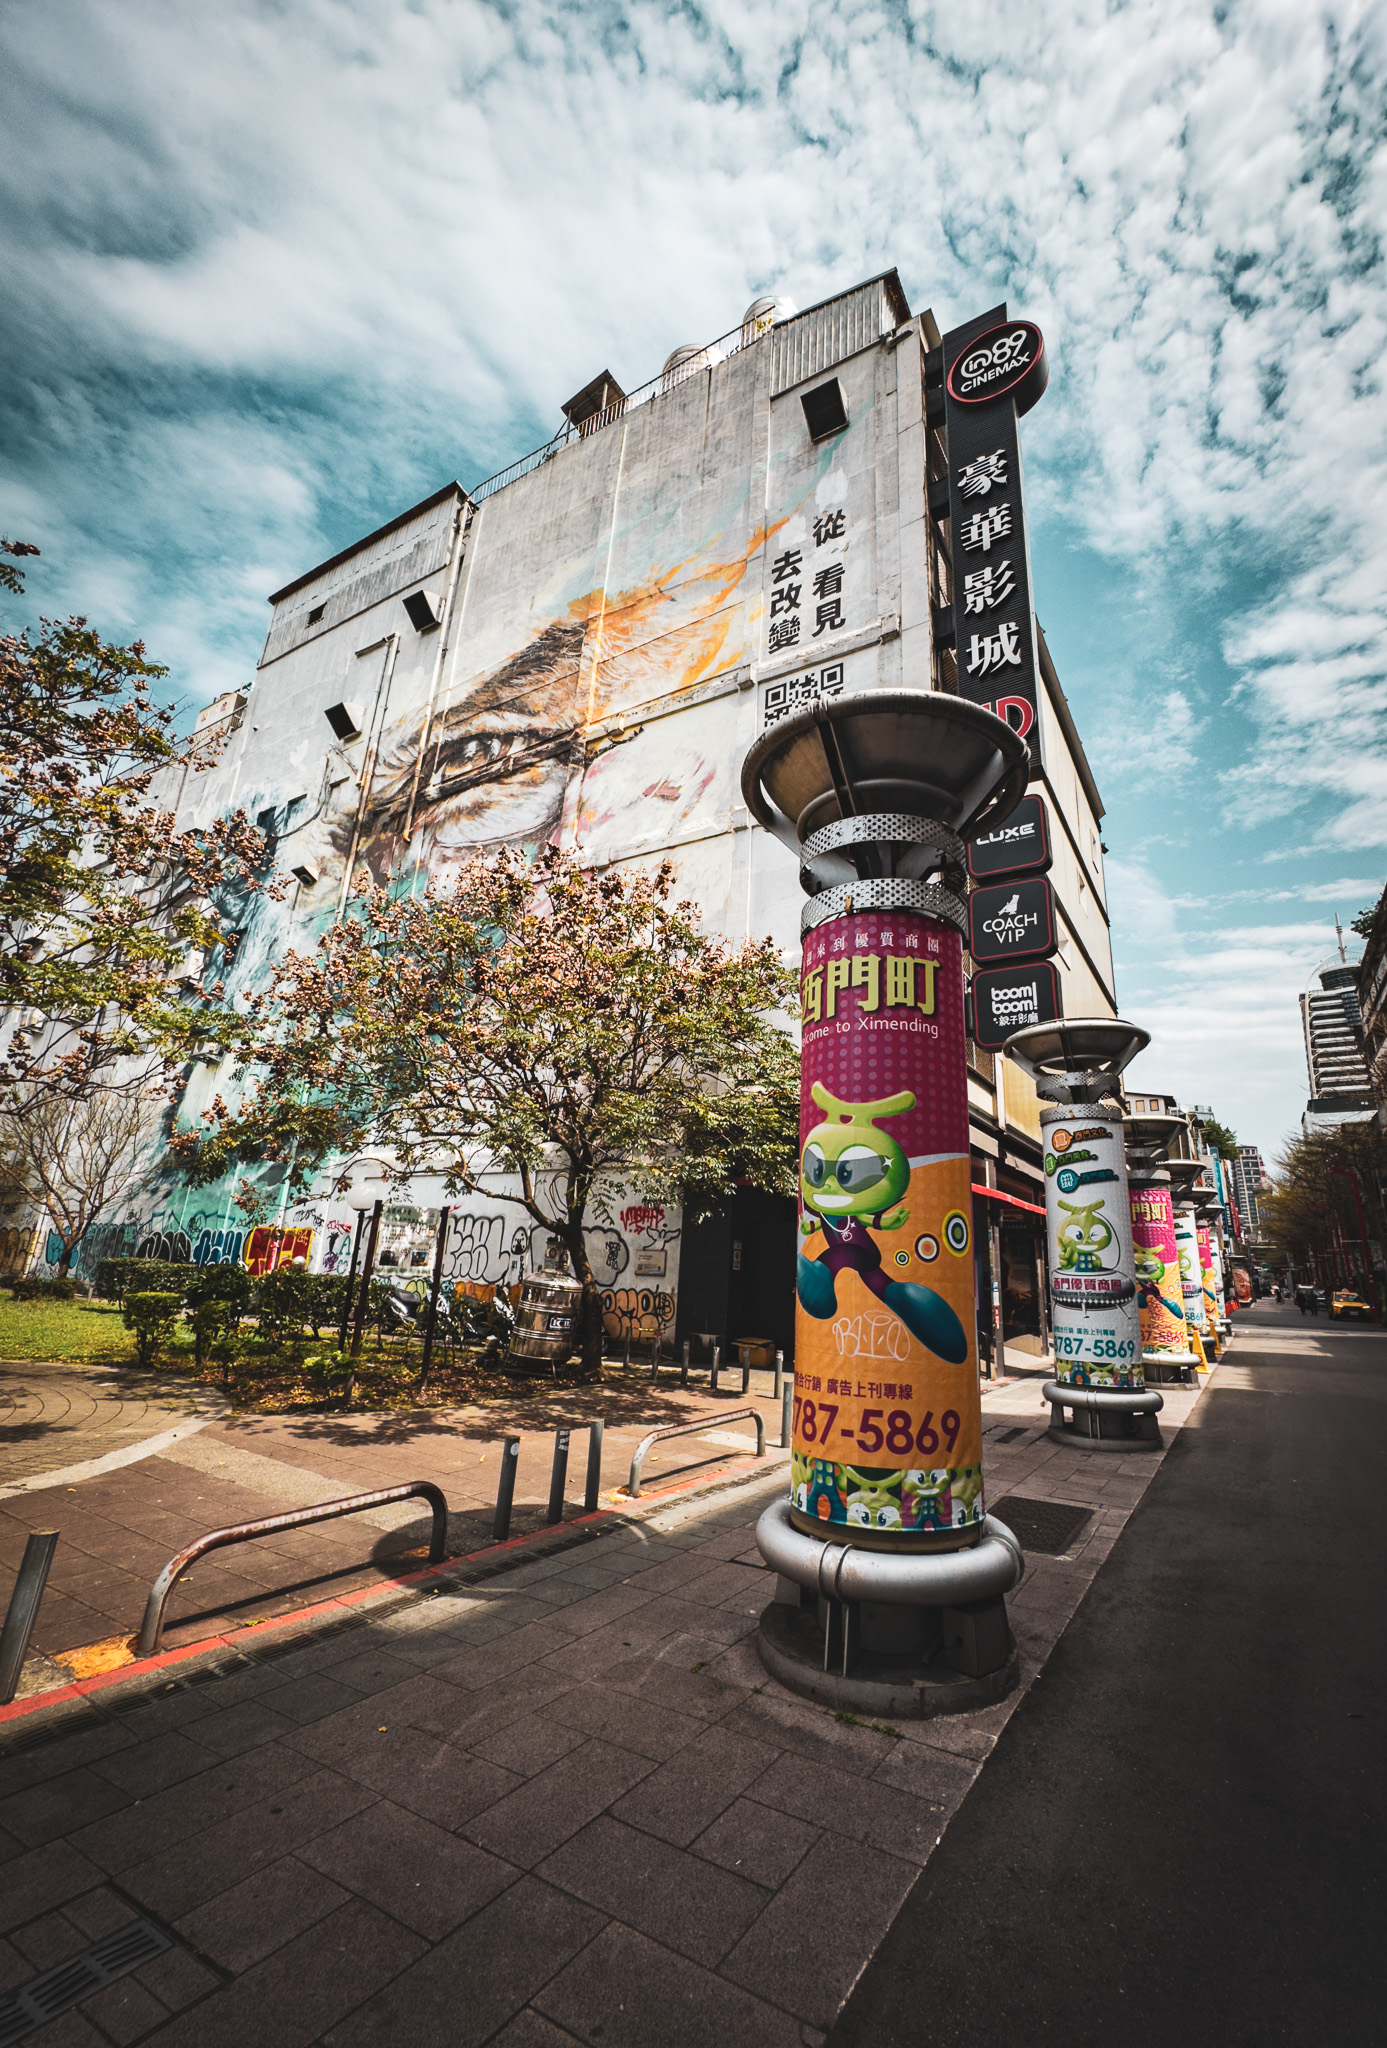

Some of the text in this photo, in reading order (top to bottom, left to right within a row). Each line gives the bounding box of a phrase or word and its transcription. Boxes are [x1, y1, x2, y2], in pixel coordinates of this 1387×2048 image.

[961, 351, 1030, 392] CINEMAX
[957, 449, 1022, 678] 豪華影城
[768, 549, 803, 655] 去改變
[976, 822, 1035, 845] LUXE
[982, 912, 1037, 932] COACH
[996, 928, 1025, 943] VIP
[802, 953, 941, 1026] 西門町
[991, 986, 1032, 1001] boom
[836, 1021, 851, 1033] to
[858, 1017, 938, 1039] Ximending
[826, 1378, 913, 1400] 廣告上刊專線
